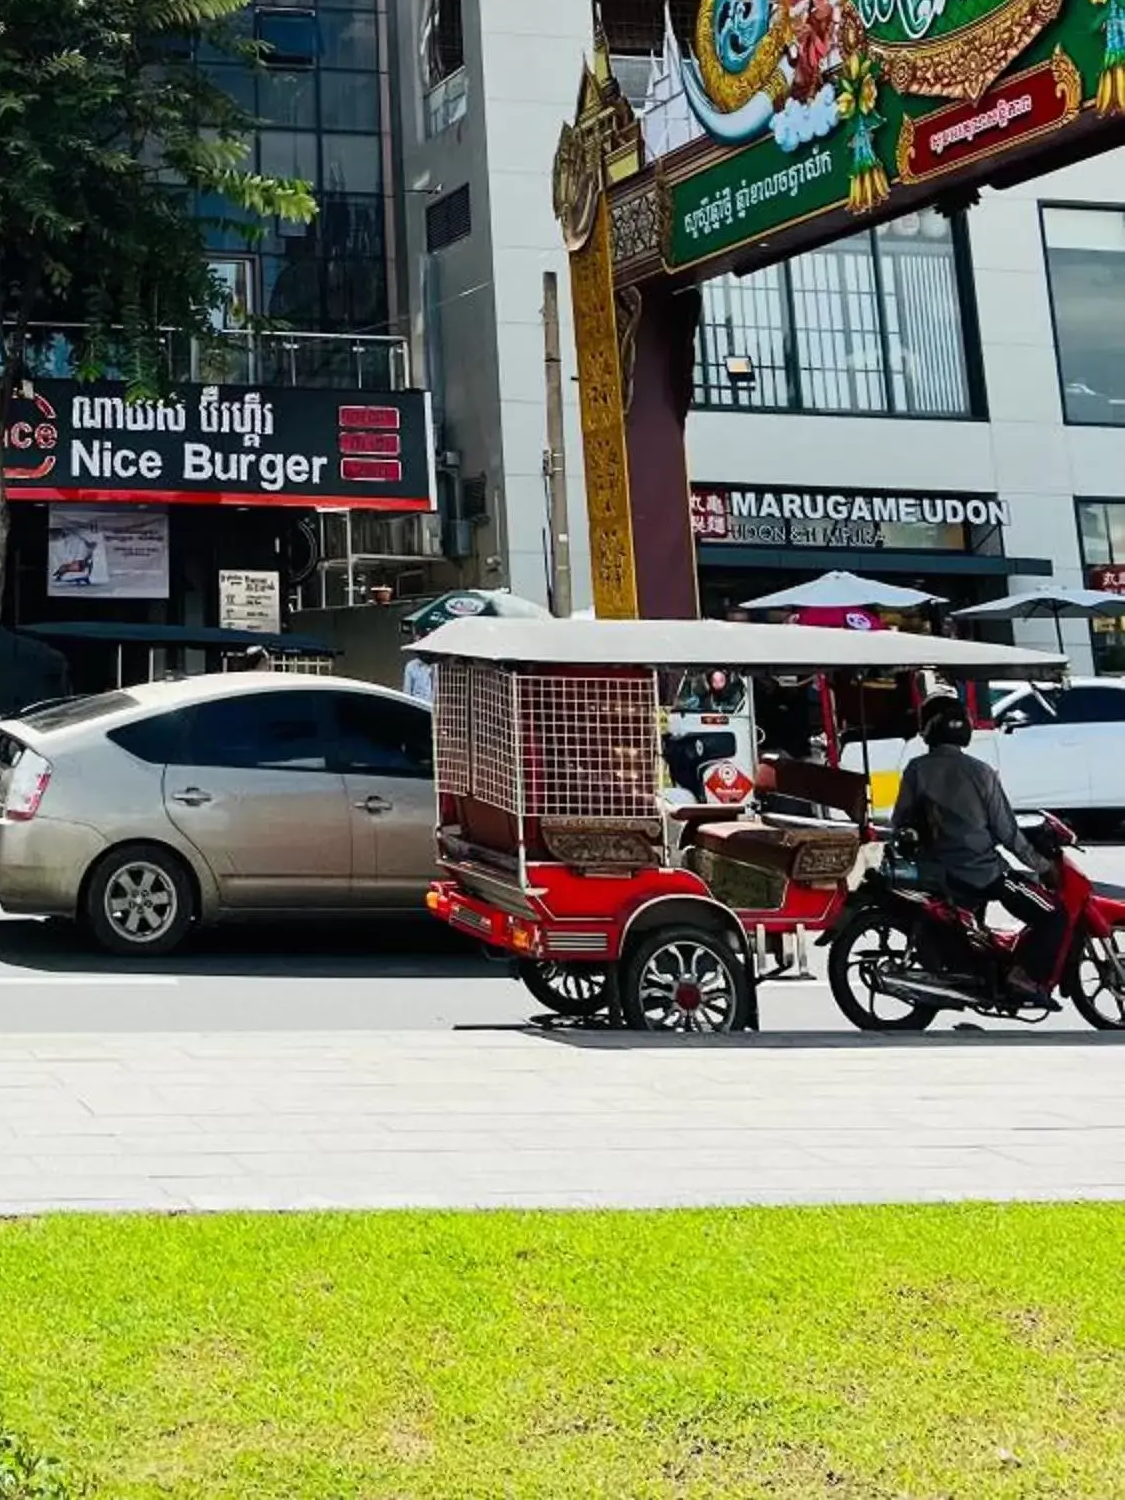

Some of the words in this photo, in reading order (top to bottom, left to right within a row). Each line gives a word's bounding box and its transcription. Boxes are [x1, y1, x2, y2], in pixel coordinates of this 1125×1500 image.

[71, 439, 163, 480] Nice
[183, 442, 328, 491] Burger
[729, 491, 919, 523] MARUGAME
[922, 498, 1011, 526] UDON
